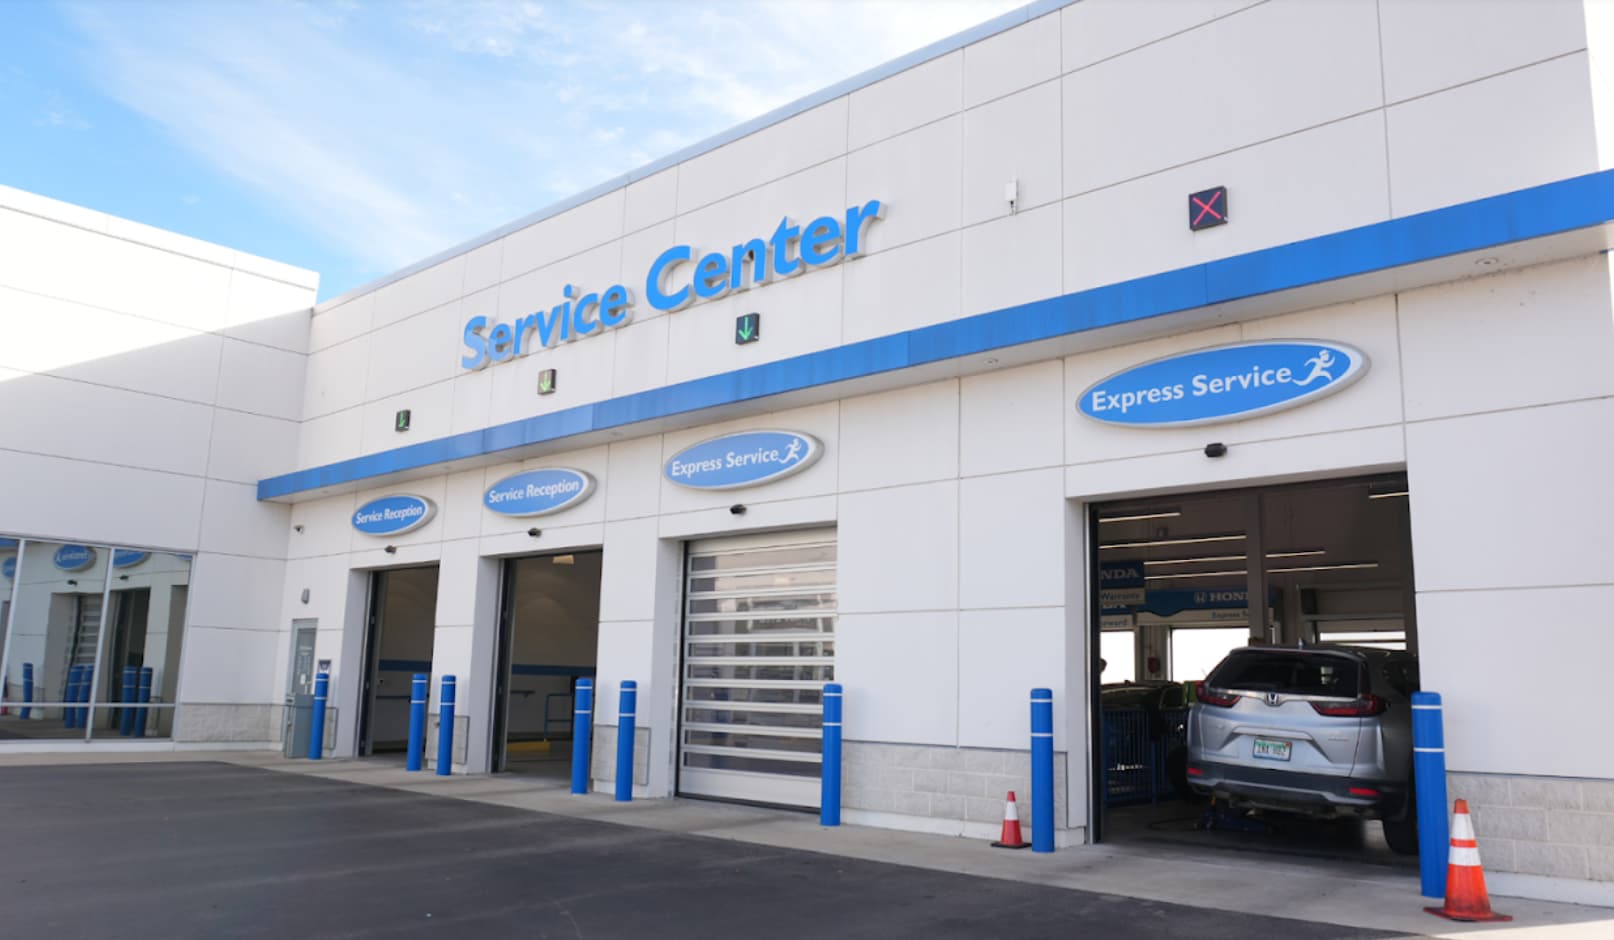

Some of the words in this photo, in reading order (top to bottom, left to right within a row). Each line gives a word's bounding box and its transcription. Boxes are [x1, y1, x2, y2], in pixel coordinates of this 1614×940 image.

[461, 284, 629, 370] Service
[646, 200, 881, 310] Center
[1092, 384, 1184, 413] Express
[1192, 366, 1292, 396] Service
[671, 459, 722, 478] Express
[726, 448, 779, 468] Service
[489, 487, 524, 503] Service
[526, 480, 580, 497] Reception
[356, 508, 383, 524] Service
[384, 505, 423, 520] Reception
